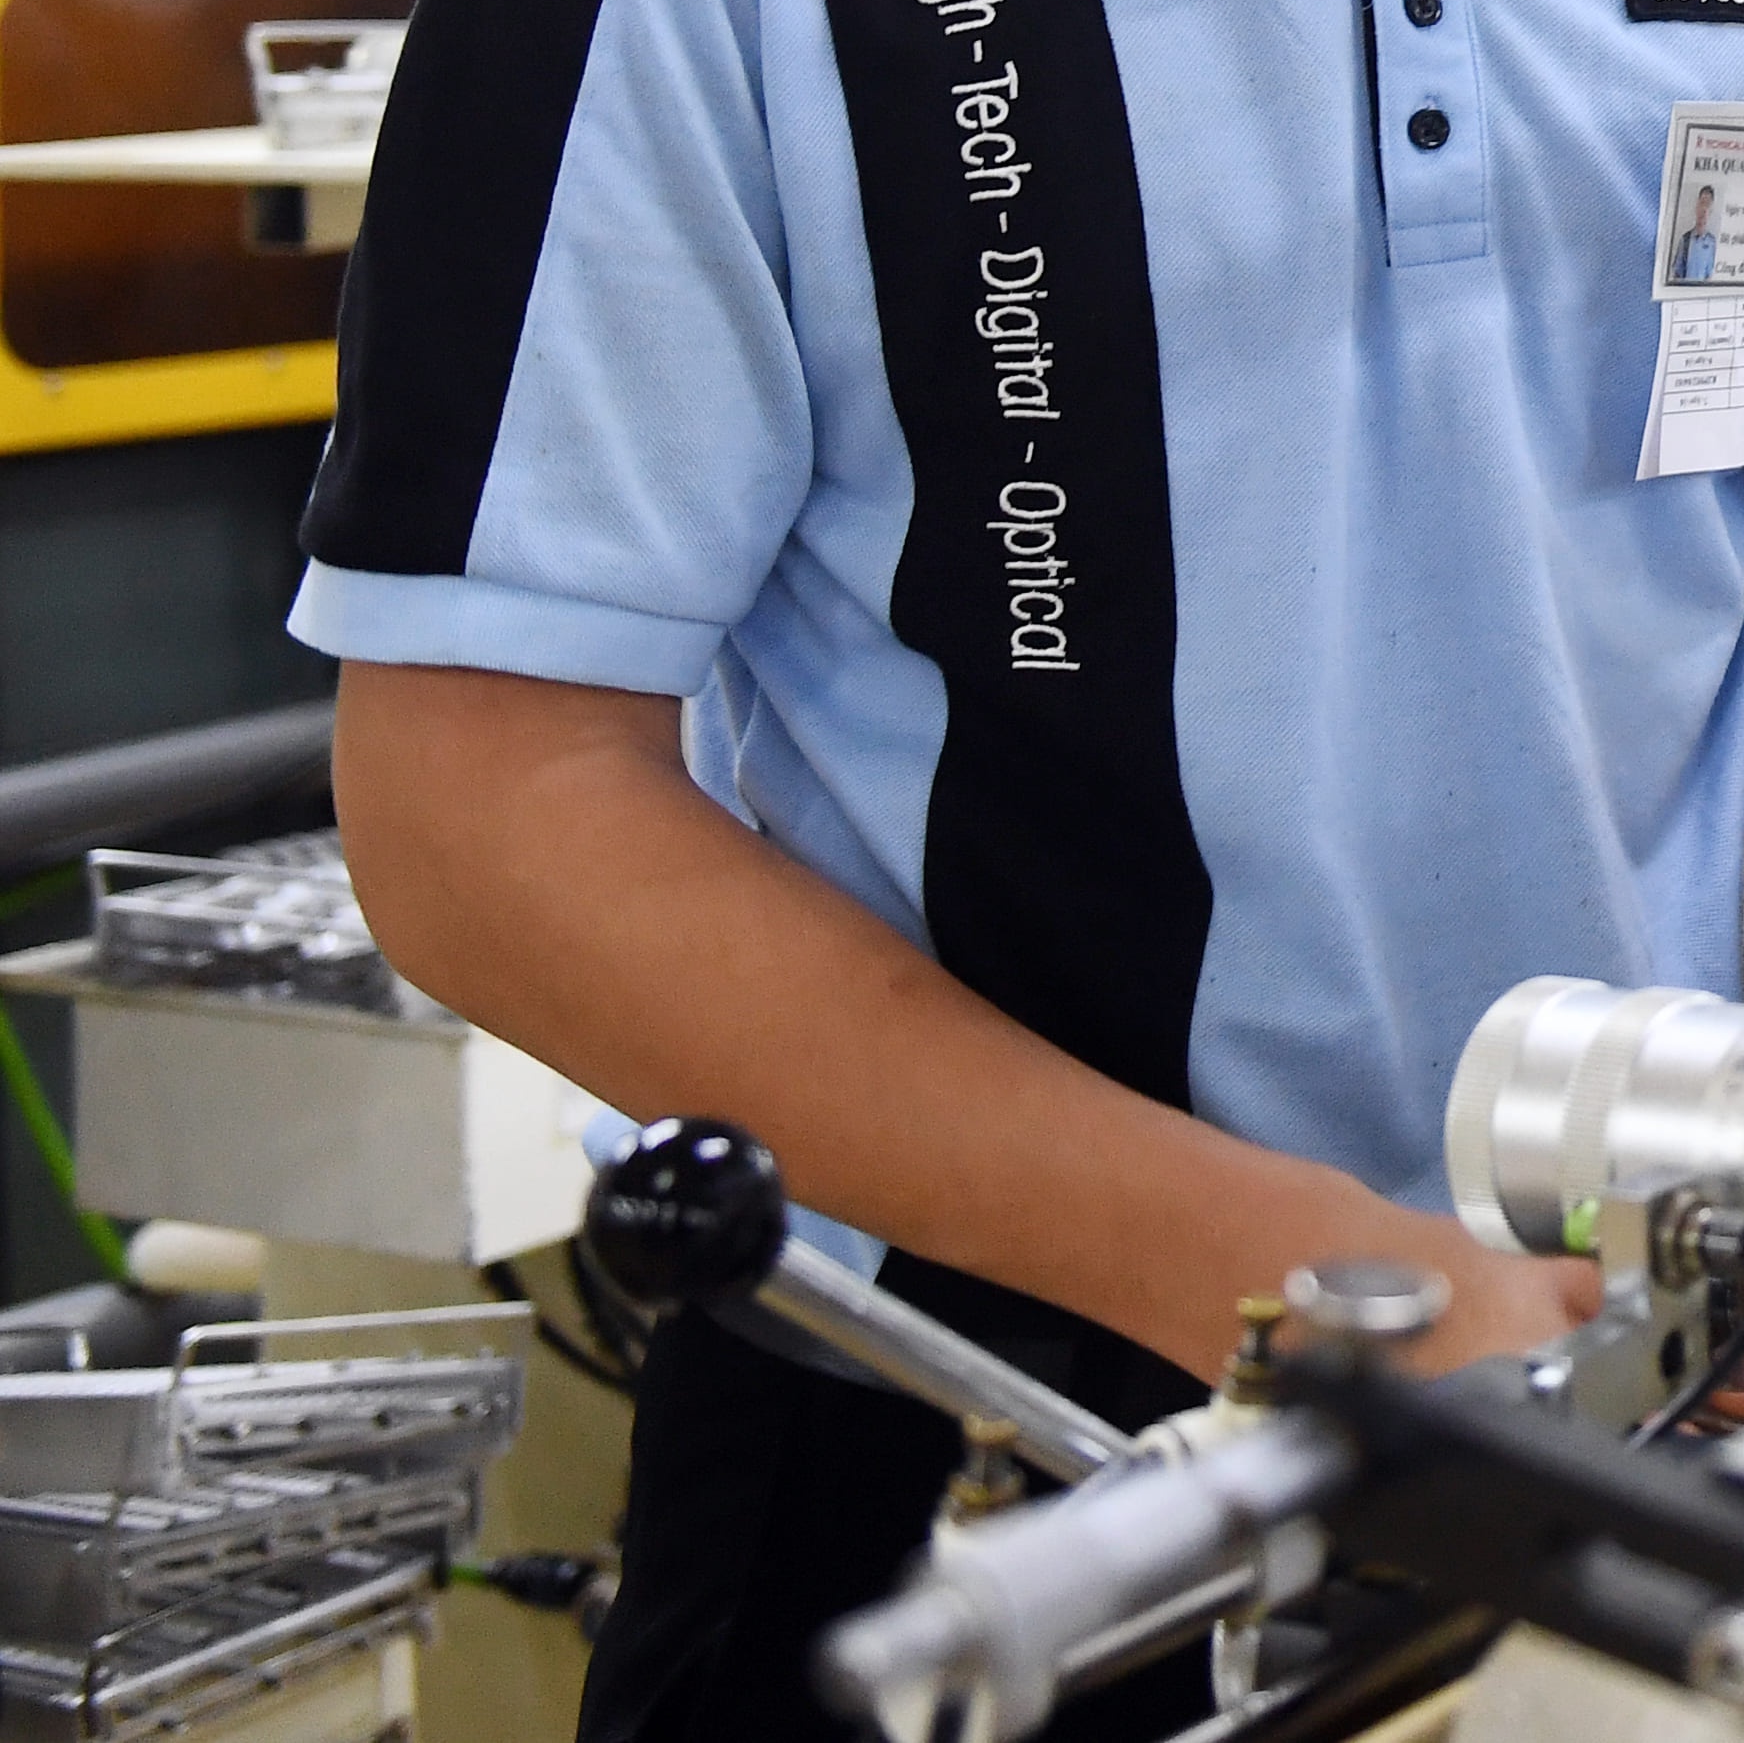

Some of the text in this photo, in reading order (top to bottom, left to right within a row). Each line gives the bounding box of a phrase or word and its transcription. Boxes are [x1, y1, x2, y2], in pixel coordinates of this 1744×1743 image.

[951, 60, 1032, 202] Tech
[975, 246, 1061, 420] Digital
[986, 481, 1081, 671] Optical
